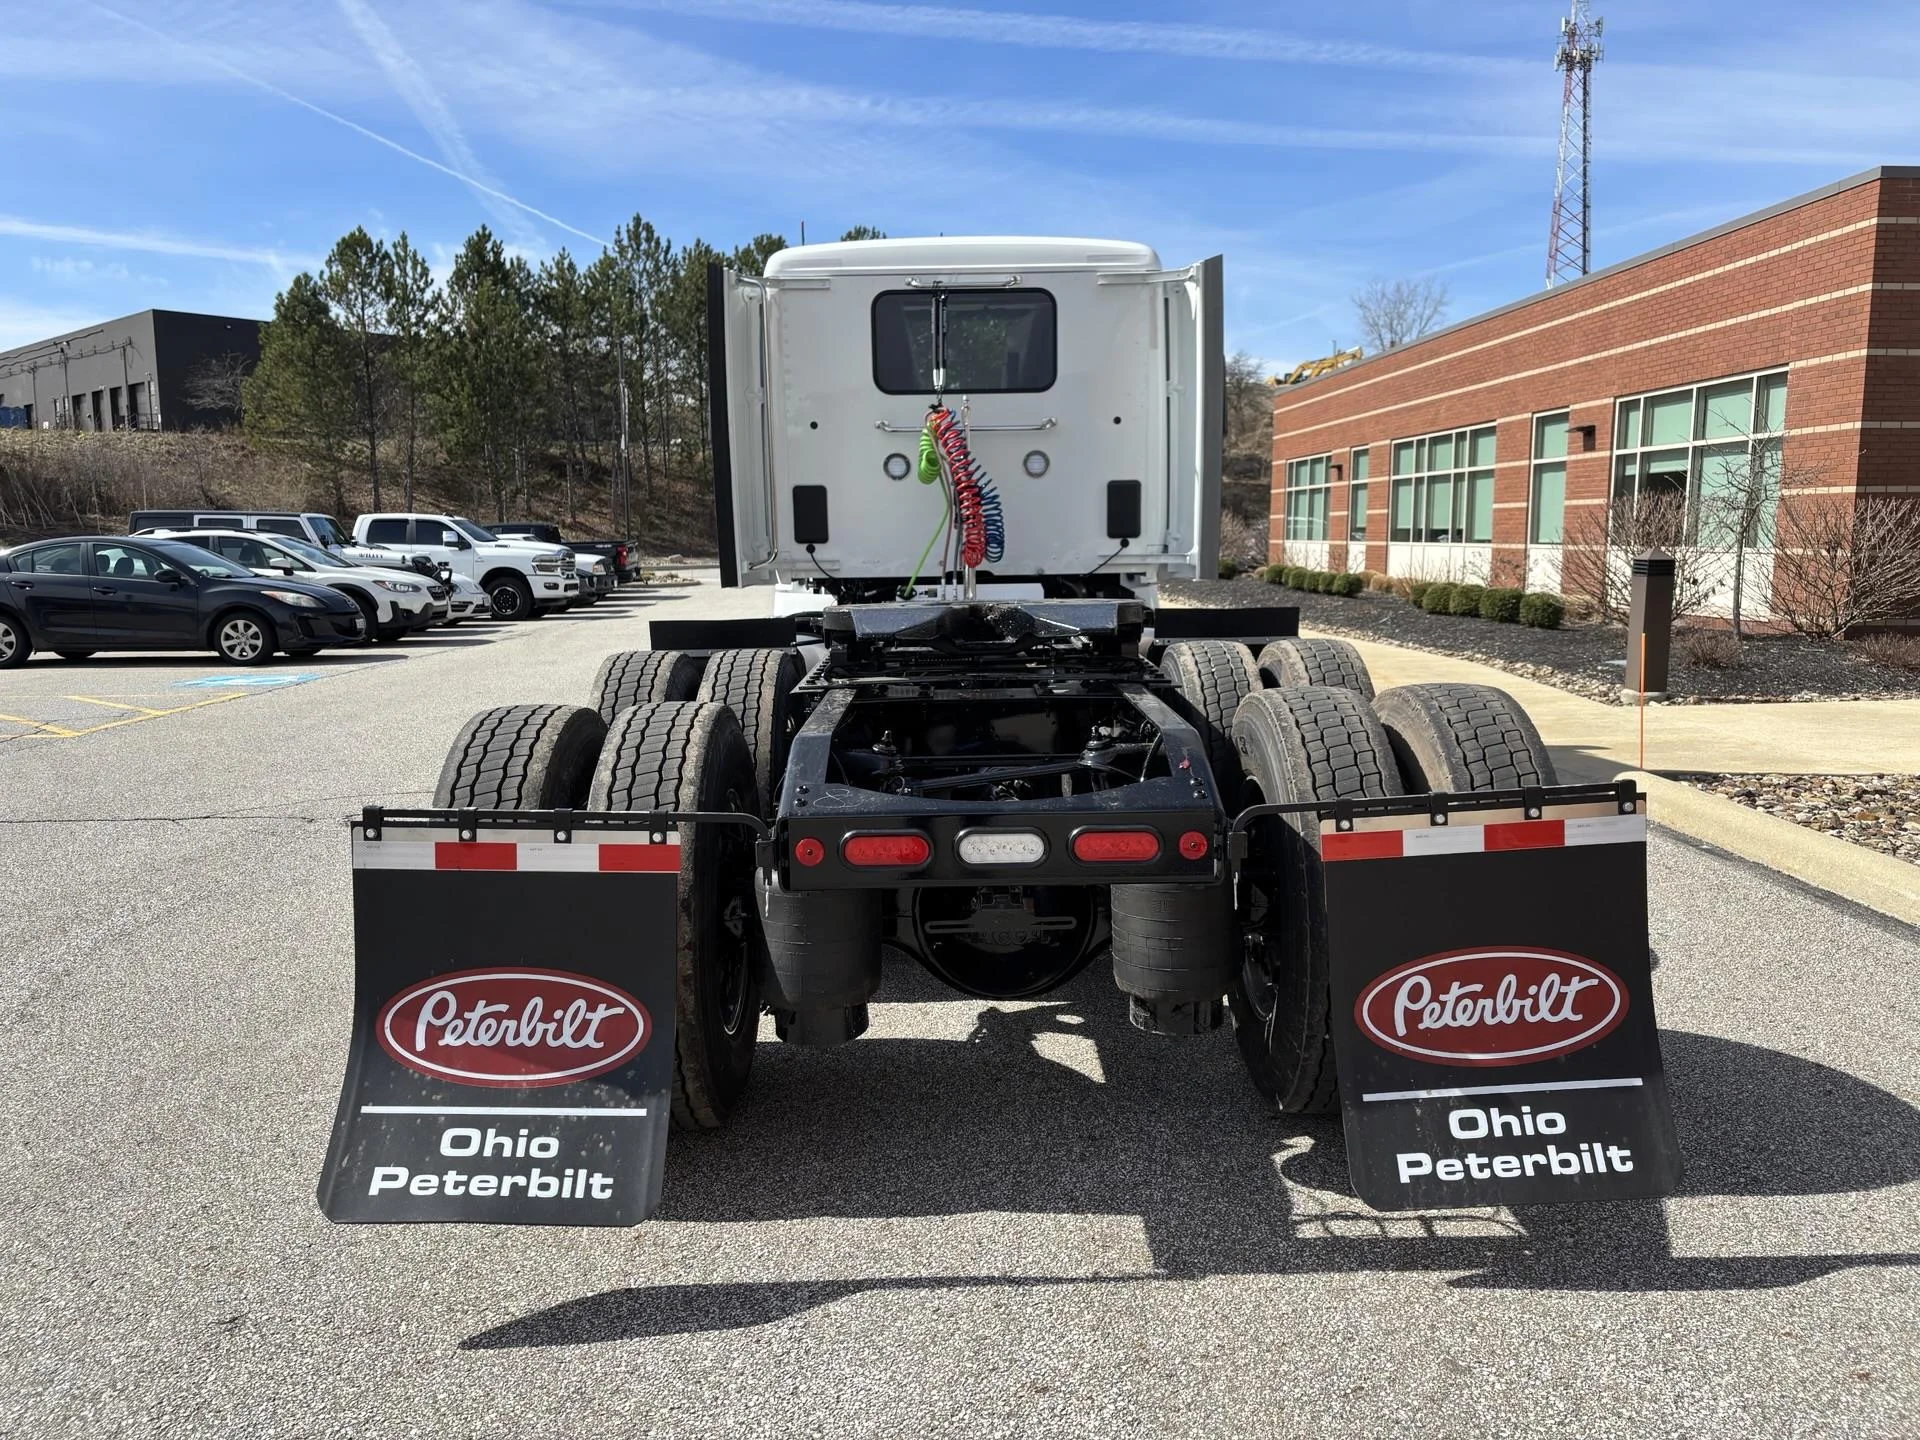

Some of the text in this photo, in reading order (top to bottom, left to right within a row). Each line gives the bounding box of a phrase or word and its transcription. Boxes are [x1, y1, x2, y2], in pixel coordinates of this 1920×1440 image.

[415, 990, 625, 1052] Peterbilt
[1394, 973, 1599, 1037] Peterbilt
[1448, 1105, 1567, 1140] Ohio
[439, 1127, 560, 1159] Ohio
[367, 1163, 614, 1200] Peterbilt
[1396, 1142, 1634, 1184] Peterbilt
